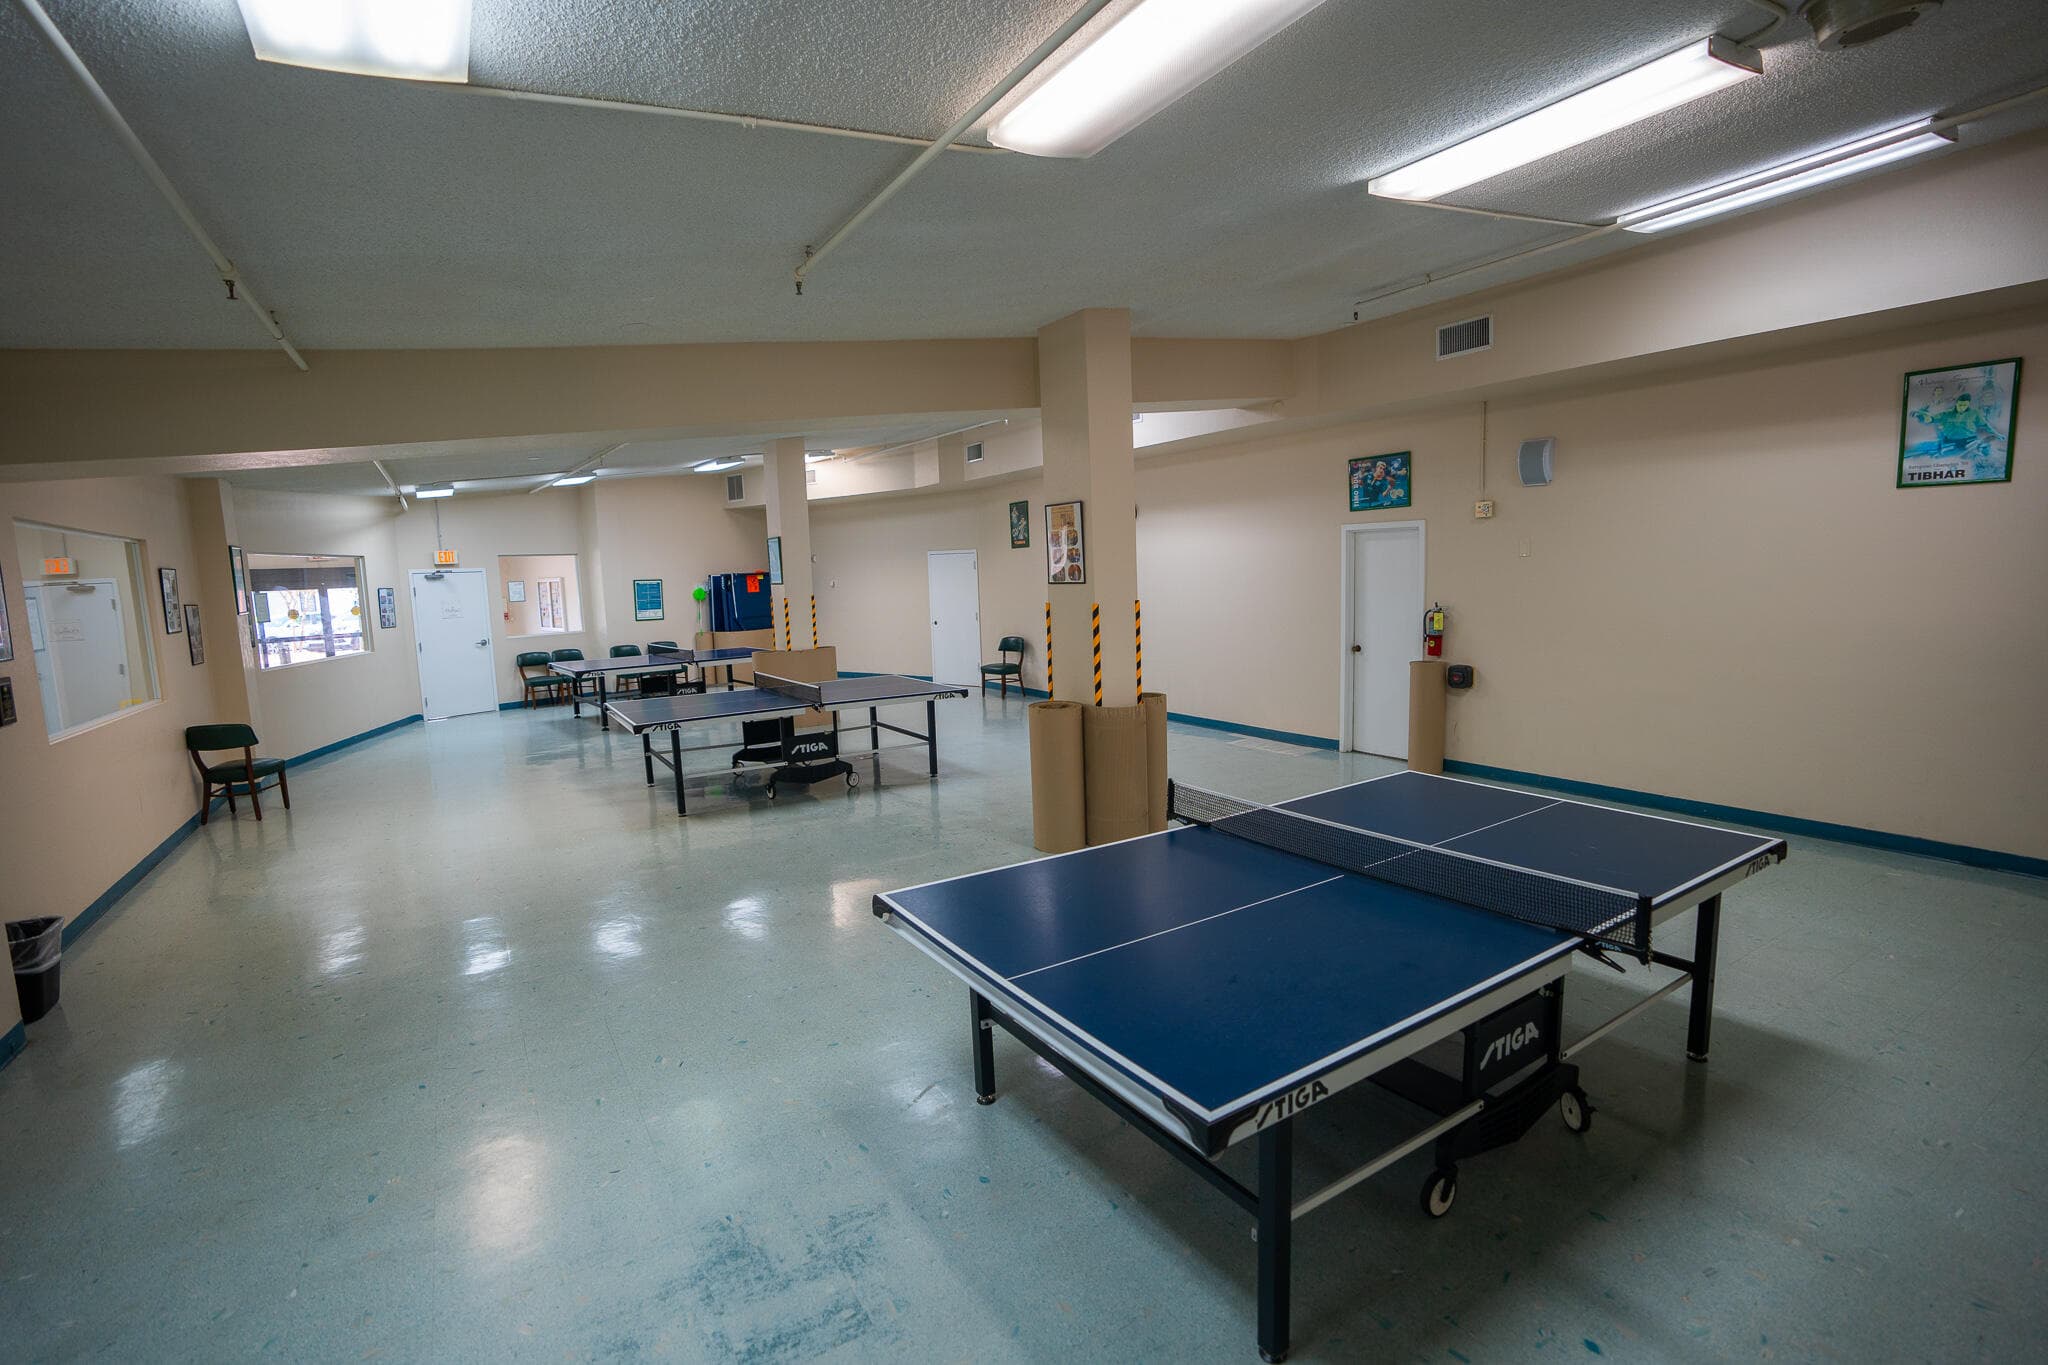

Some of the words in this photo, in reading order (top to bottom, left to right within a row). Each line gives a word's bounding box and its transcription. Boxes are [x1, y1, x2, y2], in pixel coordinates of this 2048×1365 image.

[1908, 469, 1966, 481] TIBHAR
[438, 551, 455, 563] EXIT
[652, 722, 682, 732] STIGA
[791, 742, 828, 755] STIGA
[1744, 855, 1770, 878] STIGA
[1480, 1022, 1540, 1061] STIGA
[1256, 1079, 1329, 1130] STIGA
